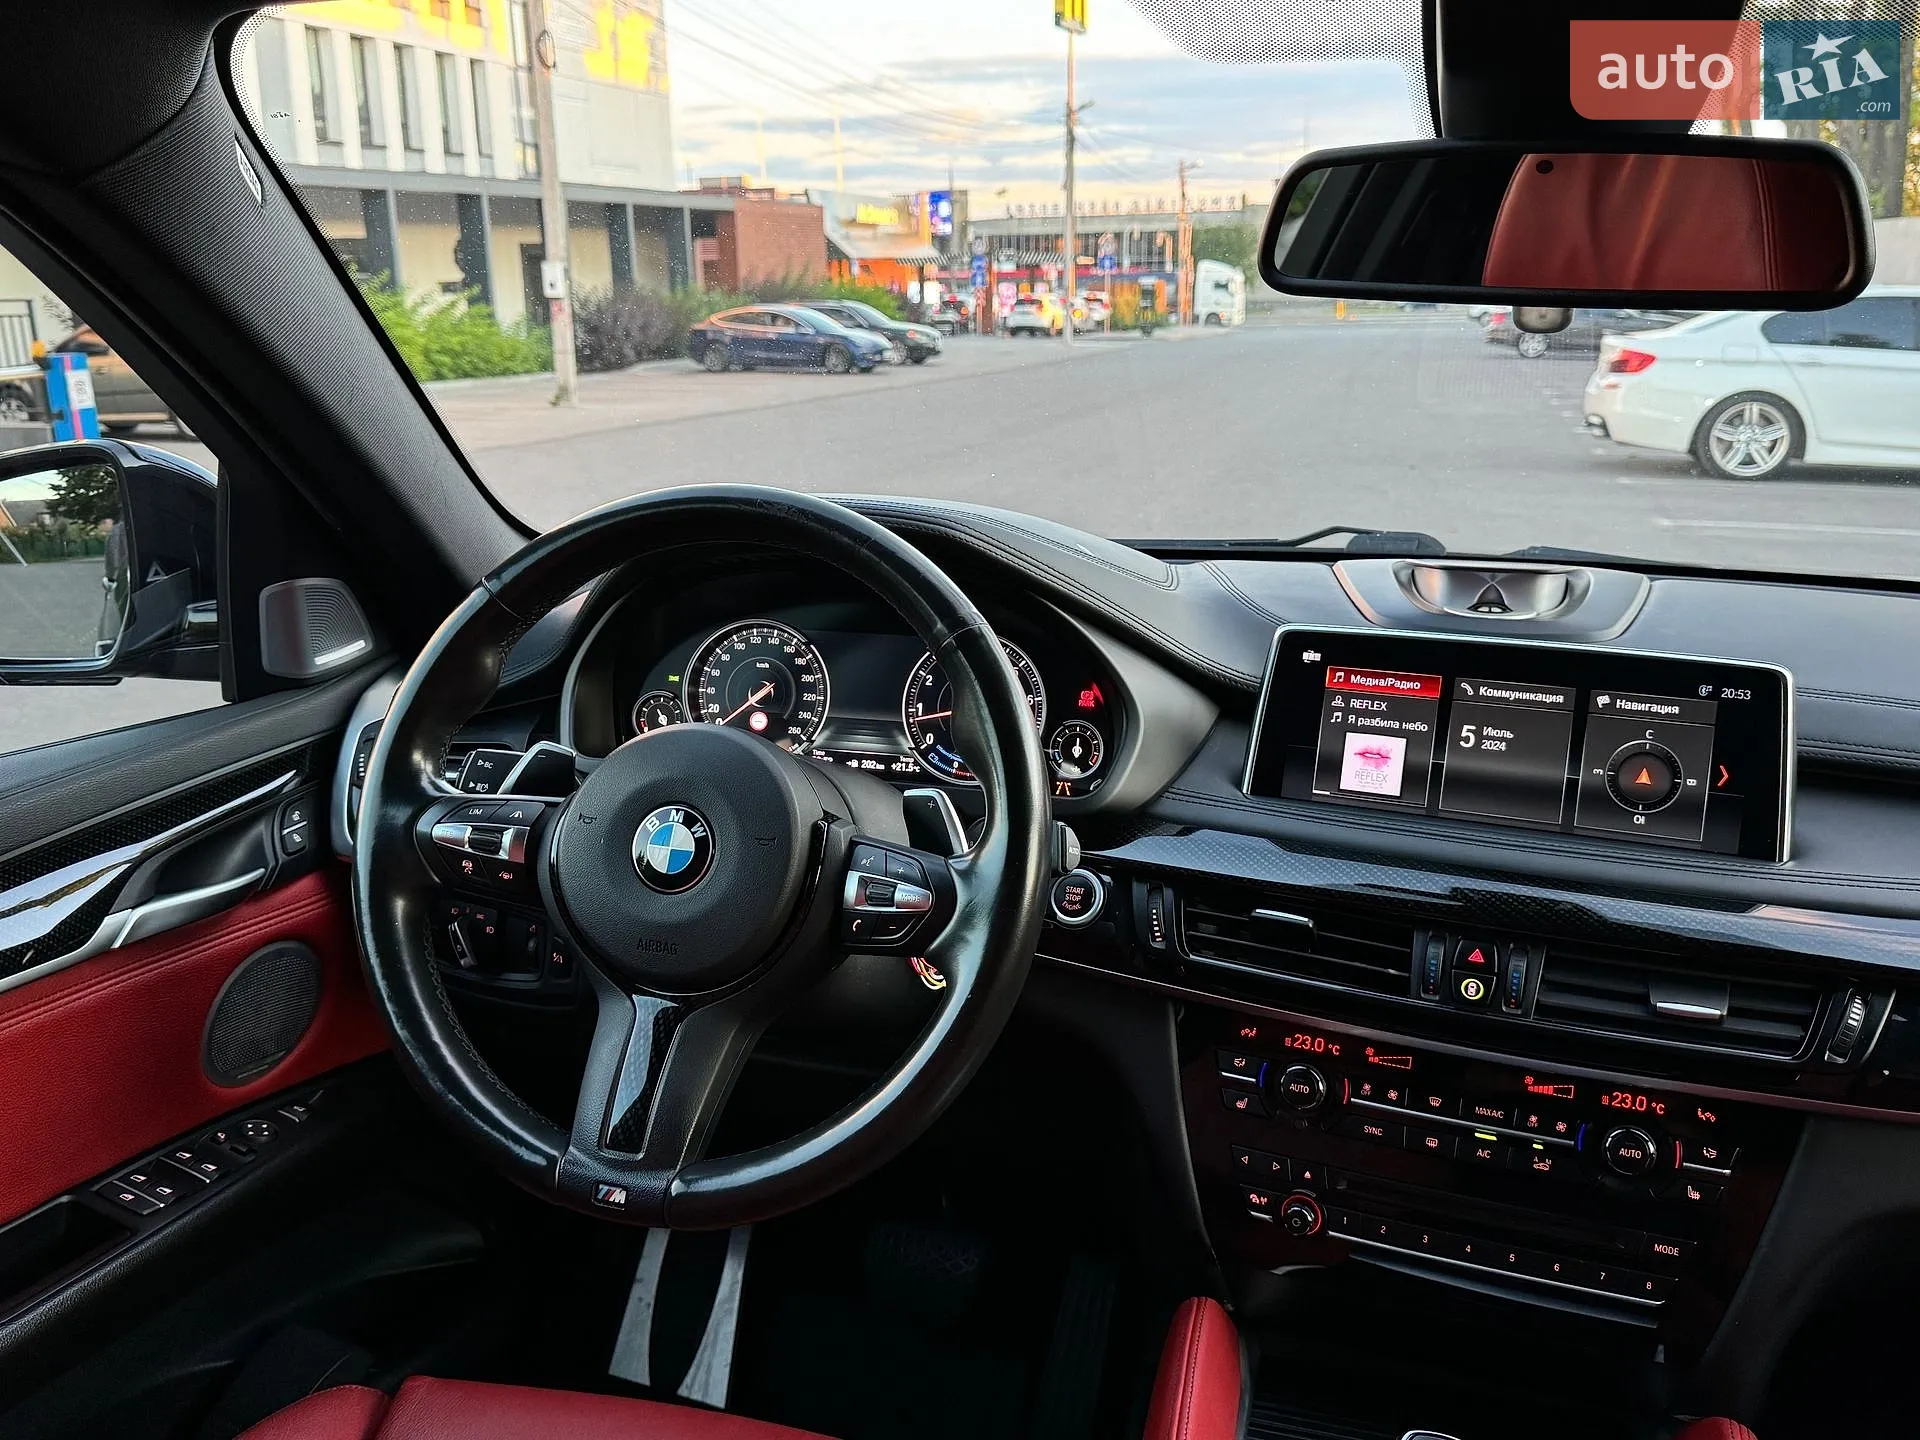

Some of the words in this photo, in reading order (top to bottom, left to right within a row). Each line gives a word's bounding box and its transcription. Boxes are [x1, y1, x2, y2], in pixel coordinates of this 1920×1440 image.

[750, 636, 762, 644] 120
[767, 637, 780, 645] 140
[734, 643, 746, 651] 100
[784, 646, 796, 654] 160
[721, 654, 731, 662] 80
[794, 657, 807, 665] 180
[711, 669, 721, 677] 60
[801, 675, 815, 683] 200
[925, 675, 933, 686] 2
[1350, 674, 1421, 690] Медиа/Радио
[706, 687, 716, 695] 40
[1479, 686, 1565, 703] Коммуникация
[1721, 688, 1751, 700] 20:53
[803, 693, 816, 701] 220
[708, 703, 720, 714] 20
[1350, 699, 1388, 711] REFLEX
[1616, 699, 1680, 715] Навигация
[798, 711, 811, 720] 240
[1348, 714, 1356, 724] Я
[1357, 716, 1400, 729] разбила
[1402, 722, 1428, 732] небо
[788, 726, 802, 735] 260
[926, 733, 934, 745] 0
[1460, 725, 1477, 748] 5
[1483, 726, 1514, 739] Июль
[1481, 739, 1507, 752] 2024
[1354, 770, 1388, 783] REFLEX
[645, 809, 706, 839] BMW
[1065, 886, 1085, 894] START
[1064, 894, 1082, 902] STOP
[1061, 901, 1082, 910] ENGINE
[637, 938, 680, 955] AIRBAG
[1293, 1033, 1324, 1052] 23.0
[1328, 1044, 1340, 1055] °C
[1289, 1083, 1310, 1094] AUTO
[1611, 1091, 1647, 1111] 23.0
[1651, 1102, 1665, 1114] °C
[1363, 1125, 1383, 1136] SYNC
[1476, 1149, 1491, 1158] A/C
[1619, 1148, 1642, 1158] AUTO
[1343, 1216, 1347, 1225] 1
[1381, 1226, 1386, 1234] 2
[1423, 1235, 1428, 1243] 3
[1654, 1244, 1680, 1256] MODE
[1509, 1254, 1515, 1262] 5
[1600, 1272, 1606, 1280] 7
[1646, 1282, 1652, 1290] 8
